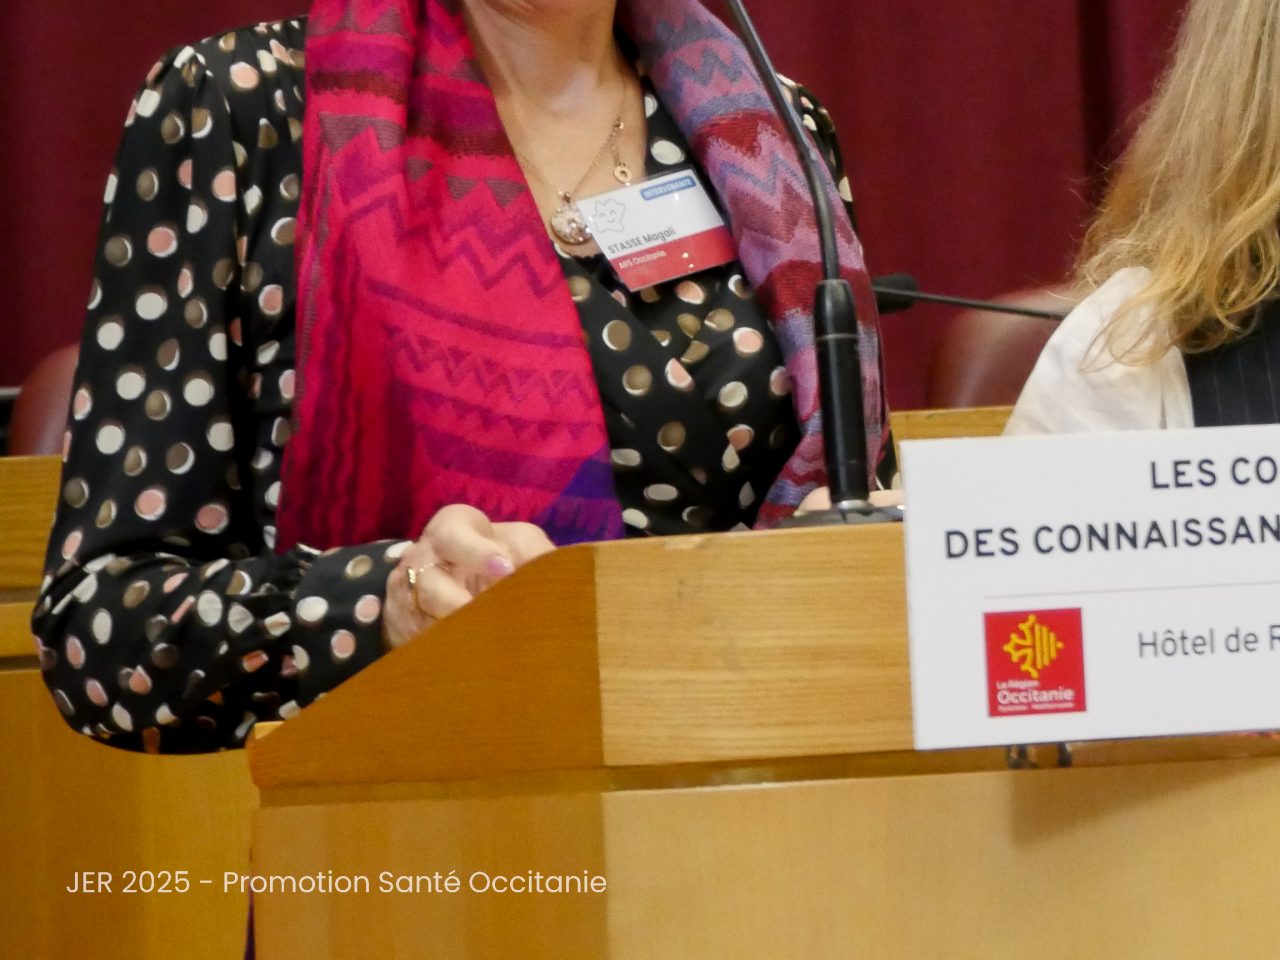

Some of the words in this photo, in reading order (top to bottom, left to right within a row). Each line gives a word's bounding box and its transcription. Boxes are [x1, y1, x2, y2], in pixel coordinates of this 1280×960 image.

[607, 237, 642, 253] STASSE
[642, 226, 676, 242] Magali
[1150, 458, 1217, 490] LES
[945, 526, 1020, 560] DES
[1138, 628, 1216, 658] Hôtel
[1224, 627, 1260, 654] de
[997, 686, 1075, 704] Occitanie
